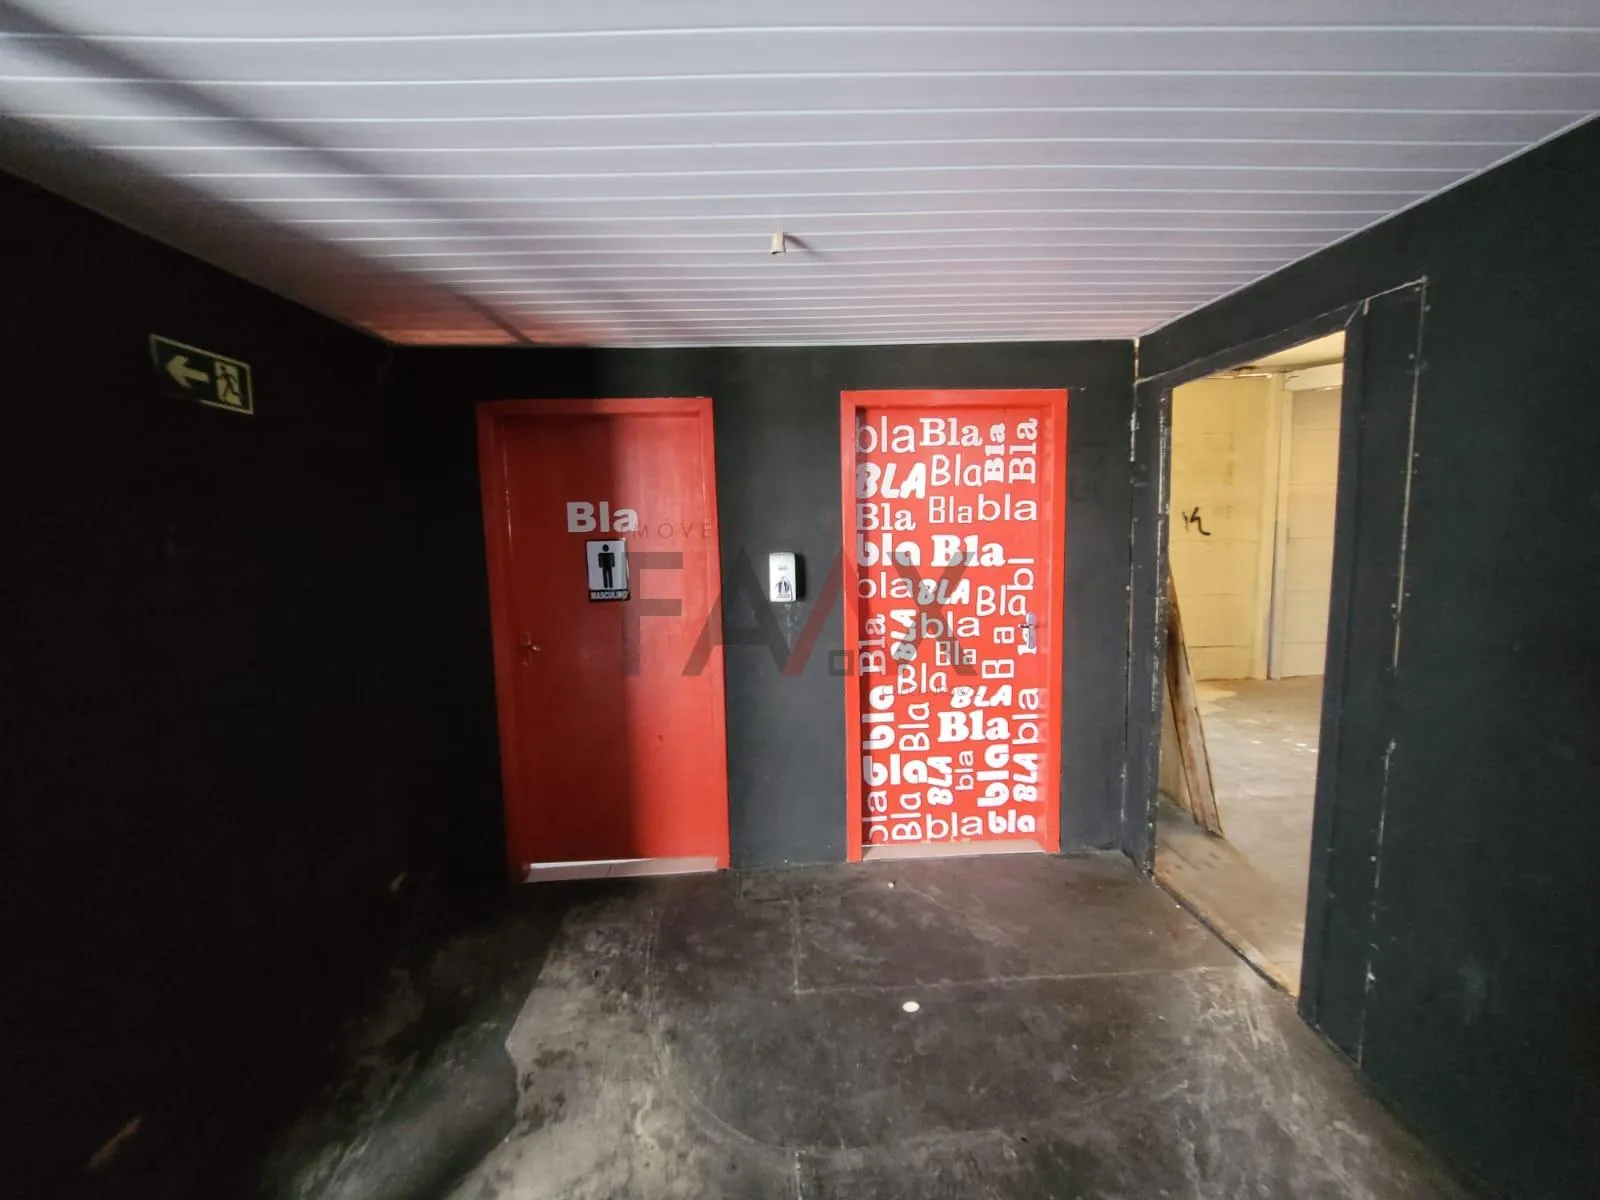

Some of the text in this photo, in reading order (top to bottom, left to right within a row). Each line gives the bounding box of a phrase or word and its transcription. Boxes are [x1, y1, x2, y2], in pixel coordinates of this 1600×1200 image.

[919, 417, 984, 447] Bla
[984, 422, 1006, 483] Bla
[1008, 418, 1038, 484] Bla
[856, 462, 927, 499] BLA
[931, 453, 983, 487] Bla
[566, 501, 638, 532] Bla
[856, 502, 916, 531] Bla
[929, 496, 973, 524] Bla
[978, 493, 1037, 521] bla
[857, 533, 920, 567] bla
[931, 534, 1006, 567] Bla
[917, 578, 970, 605] BLA
[976, 585, 1028, 616] Bla
[890, 609, 917, 662] BLA
[921, 611, 980, 639] bla
[858, 613, 886, 676] Bla
[935, 640, 977, 666] Bla
[897, 663, 948, 695] Bla
[950, 685, 1012, 708] BLA
[862, 685, 895, 750] bla
[898, 702, 930, 751] Bla
[937, 710, 1010, 743] Bla
[1011, 688, 1039, 744] bla
[863, 753, 928, 786] bla
[927, 756, 953, 806] BLA
[955, 750, 974, 790] bla
[977, 744, 1010, 807] bla
[1012, 753, 1038, 802] BLA
[891, 792, 922, 840] Bla
[926, 812, 983, 839] bla
[988, 810, 1036, 834] bla
